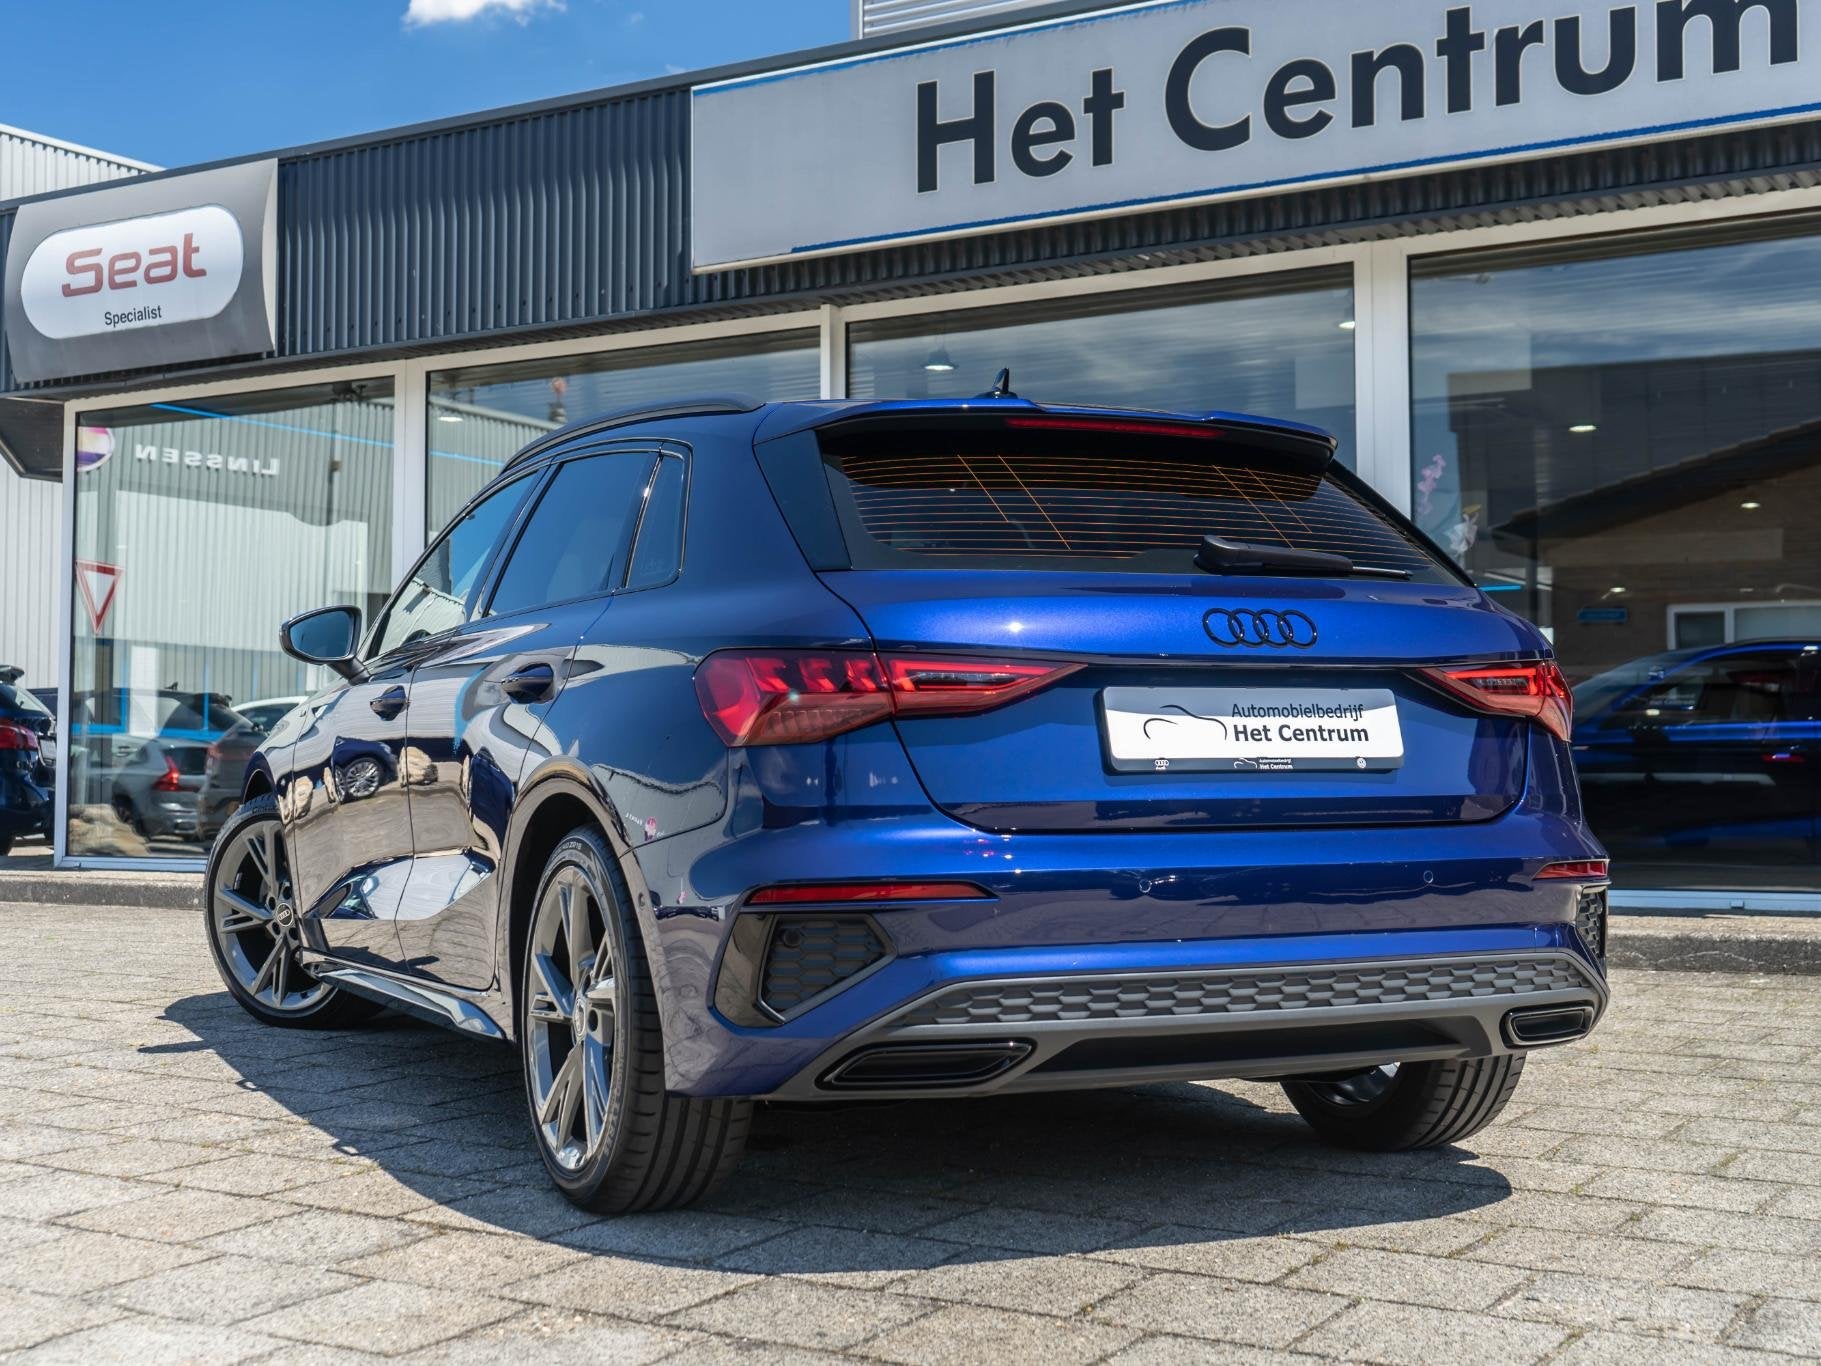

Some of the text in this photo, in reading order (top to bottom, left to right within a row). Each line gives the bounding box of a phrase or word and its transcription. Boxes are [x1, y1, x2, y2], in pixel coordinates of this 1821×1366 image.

[917, 0, 1799, 194] Het Centrum
[61, 232, 207, 297] Seat
[104, 305, 162, 327] Specialist
[1231, 703, 1364, 722] Automobielbedrijf
[1233, 724, 1369, 742] Het Centrum
